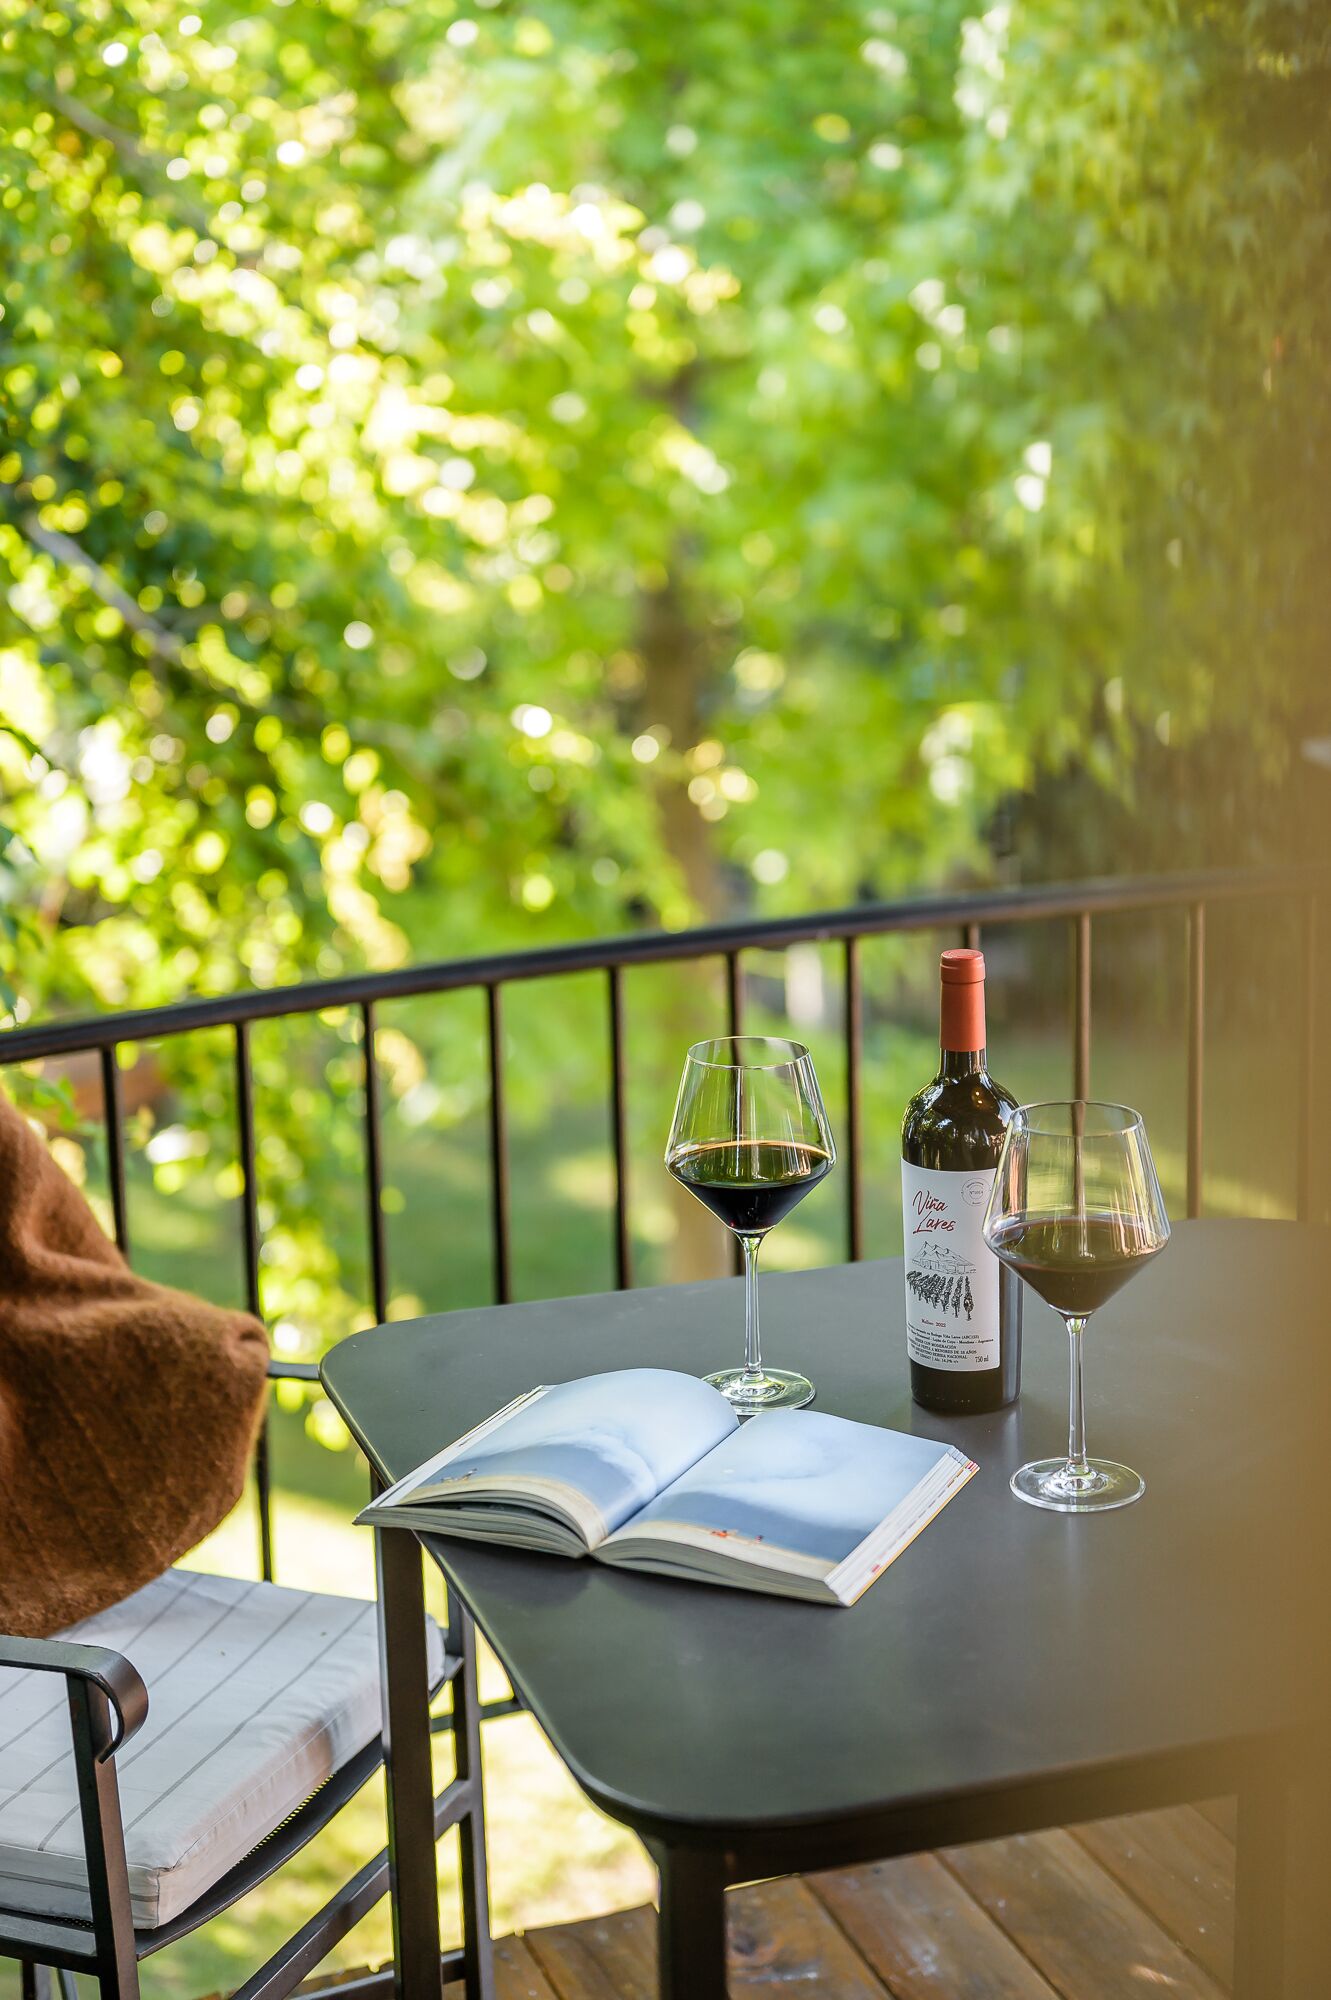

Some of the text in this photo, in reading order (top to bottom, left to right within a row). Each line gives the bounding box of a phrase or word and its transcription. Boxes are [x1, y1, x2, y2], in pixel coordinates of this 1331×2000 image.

[912, 1190, 948, 1215] Viña
[912, 1211, 956, 1234] Lares
[984, 1354, 989, 1362] ml
